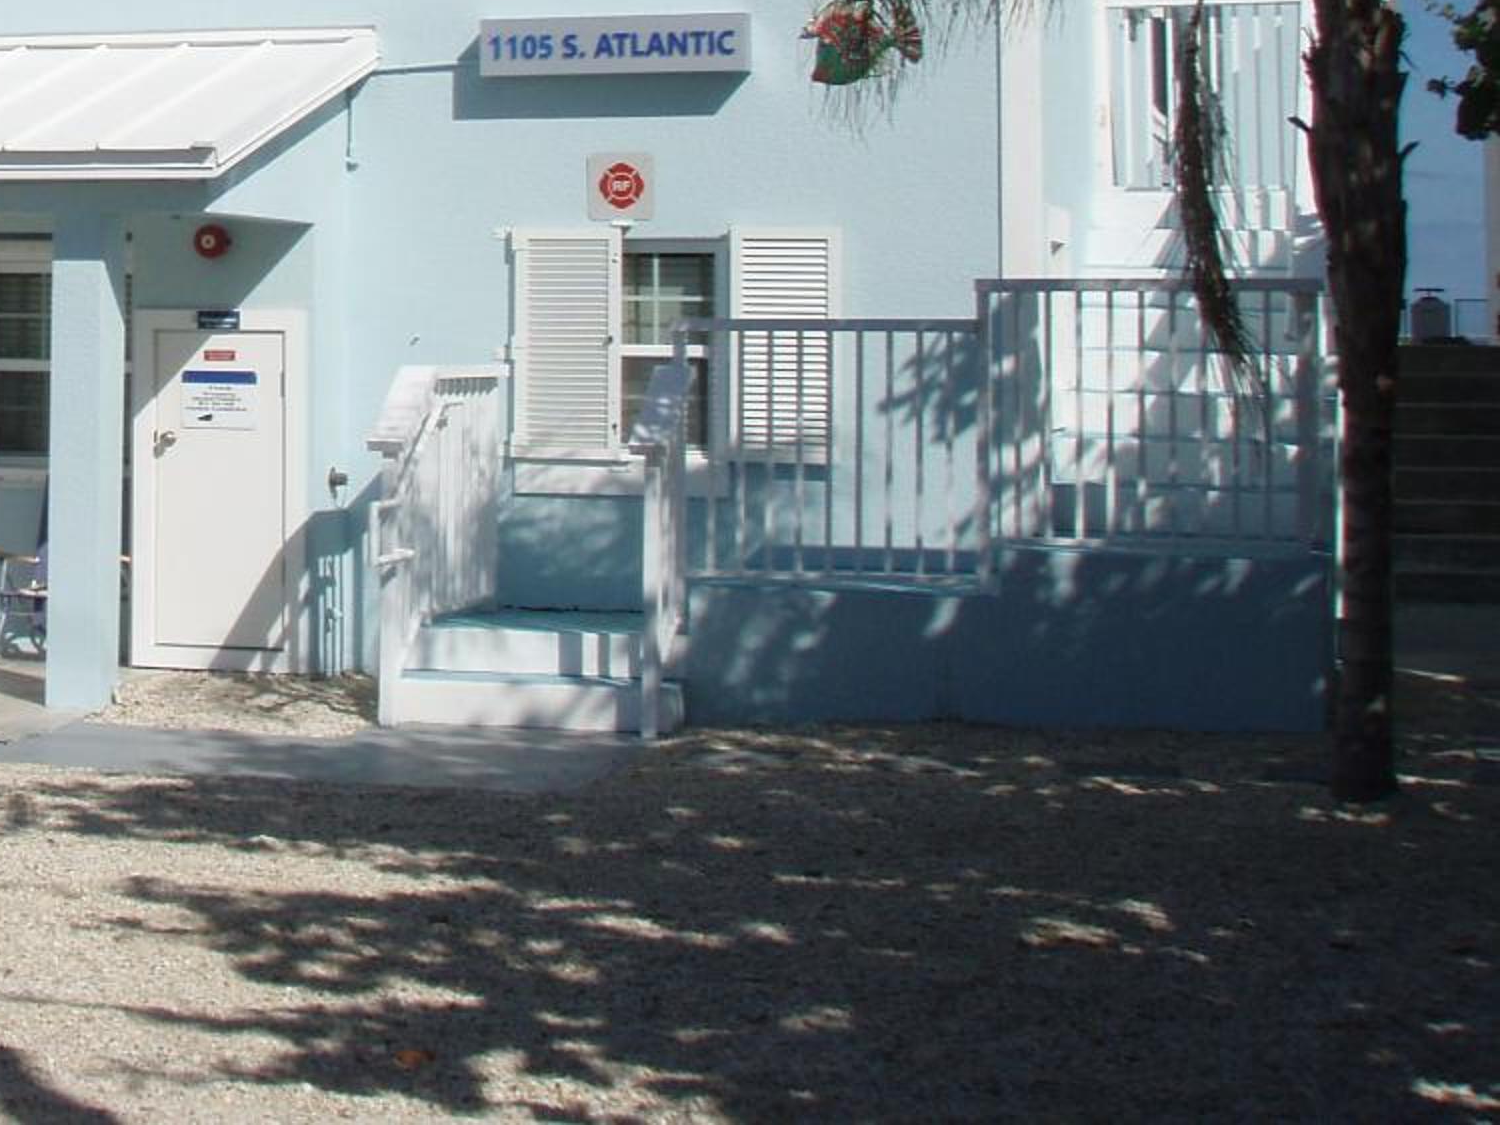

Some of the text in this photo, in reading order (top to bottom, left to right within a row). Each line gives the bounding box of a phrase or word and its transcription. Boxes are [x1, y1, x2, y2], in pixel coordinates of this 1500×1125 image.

[488, 29, 736, 60] 1105 S. ATLANTIC
